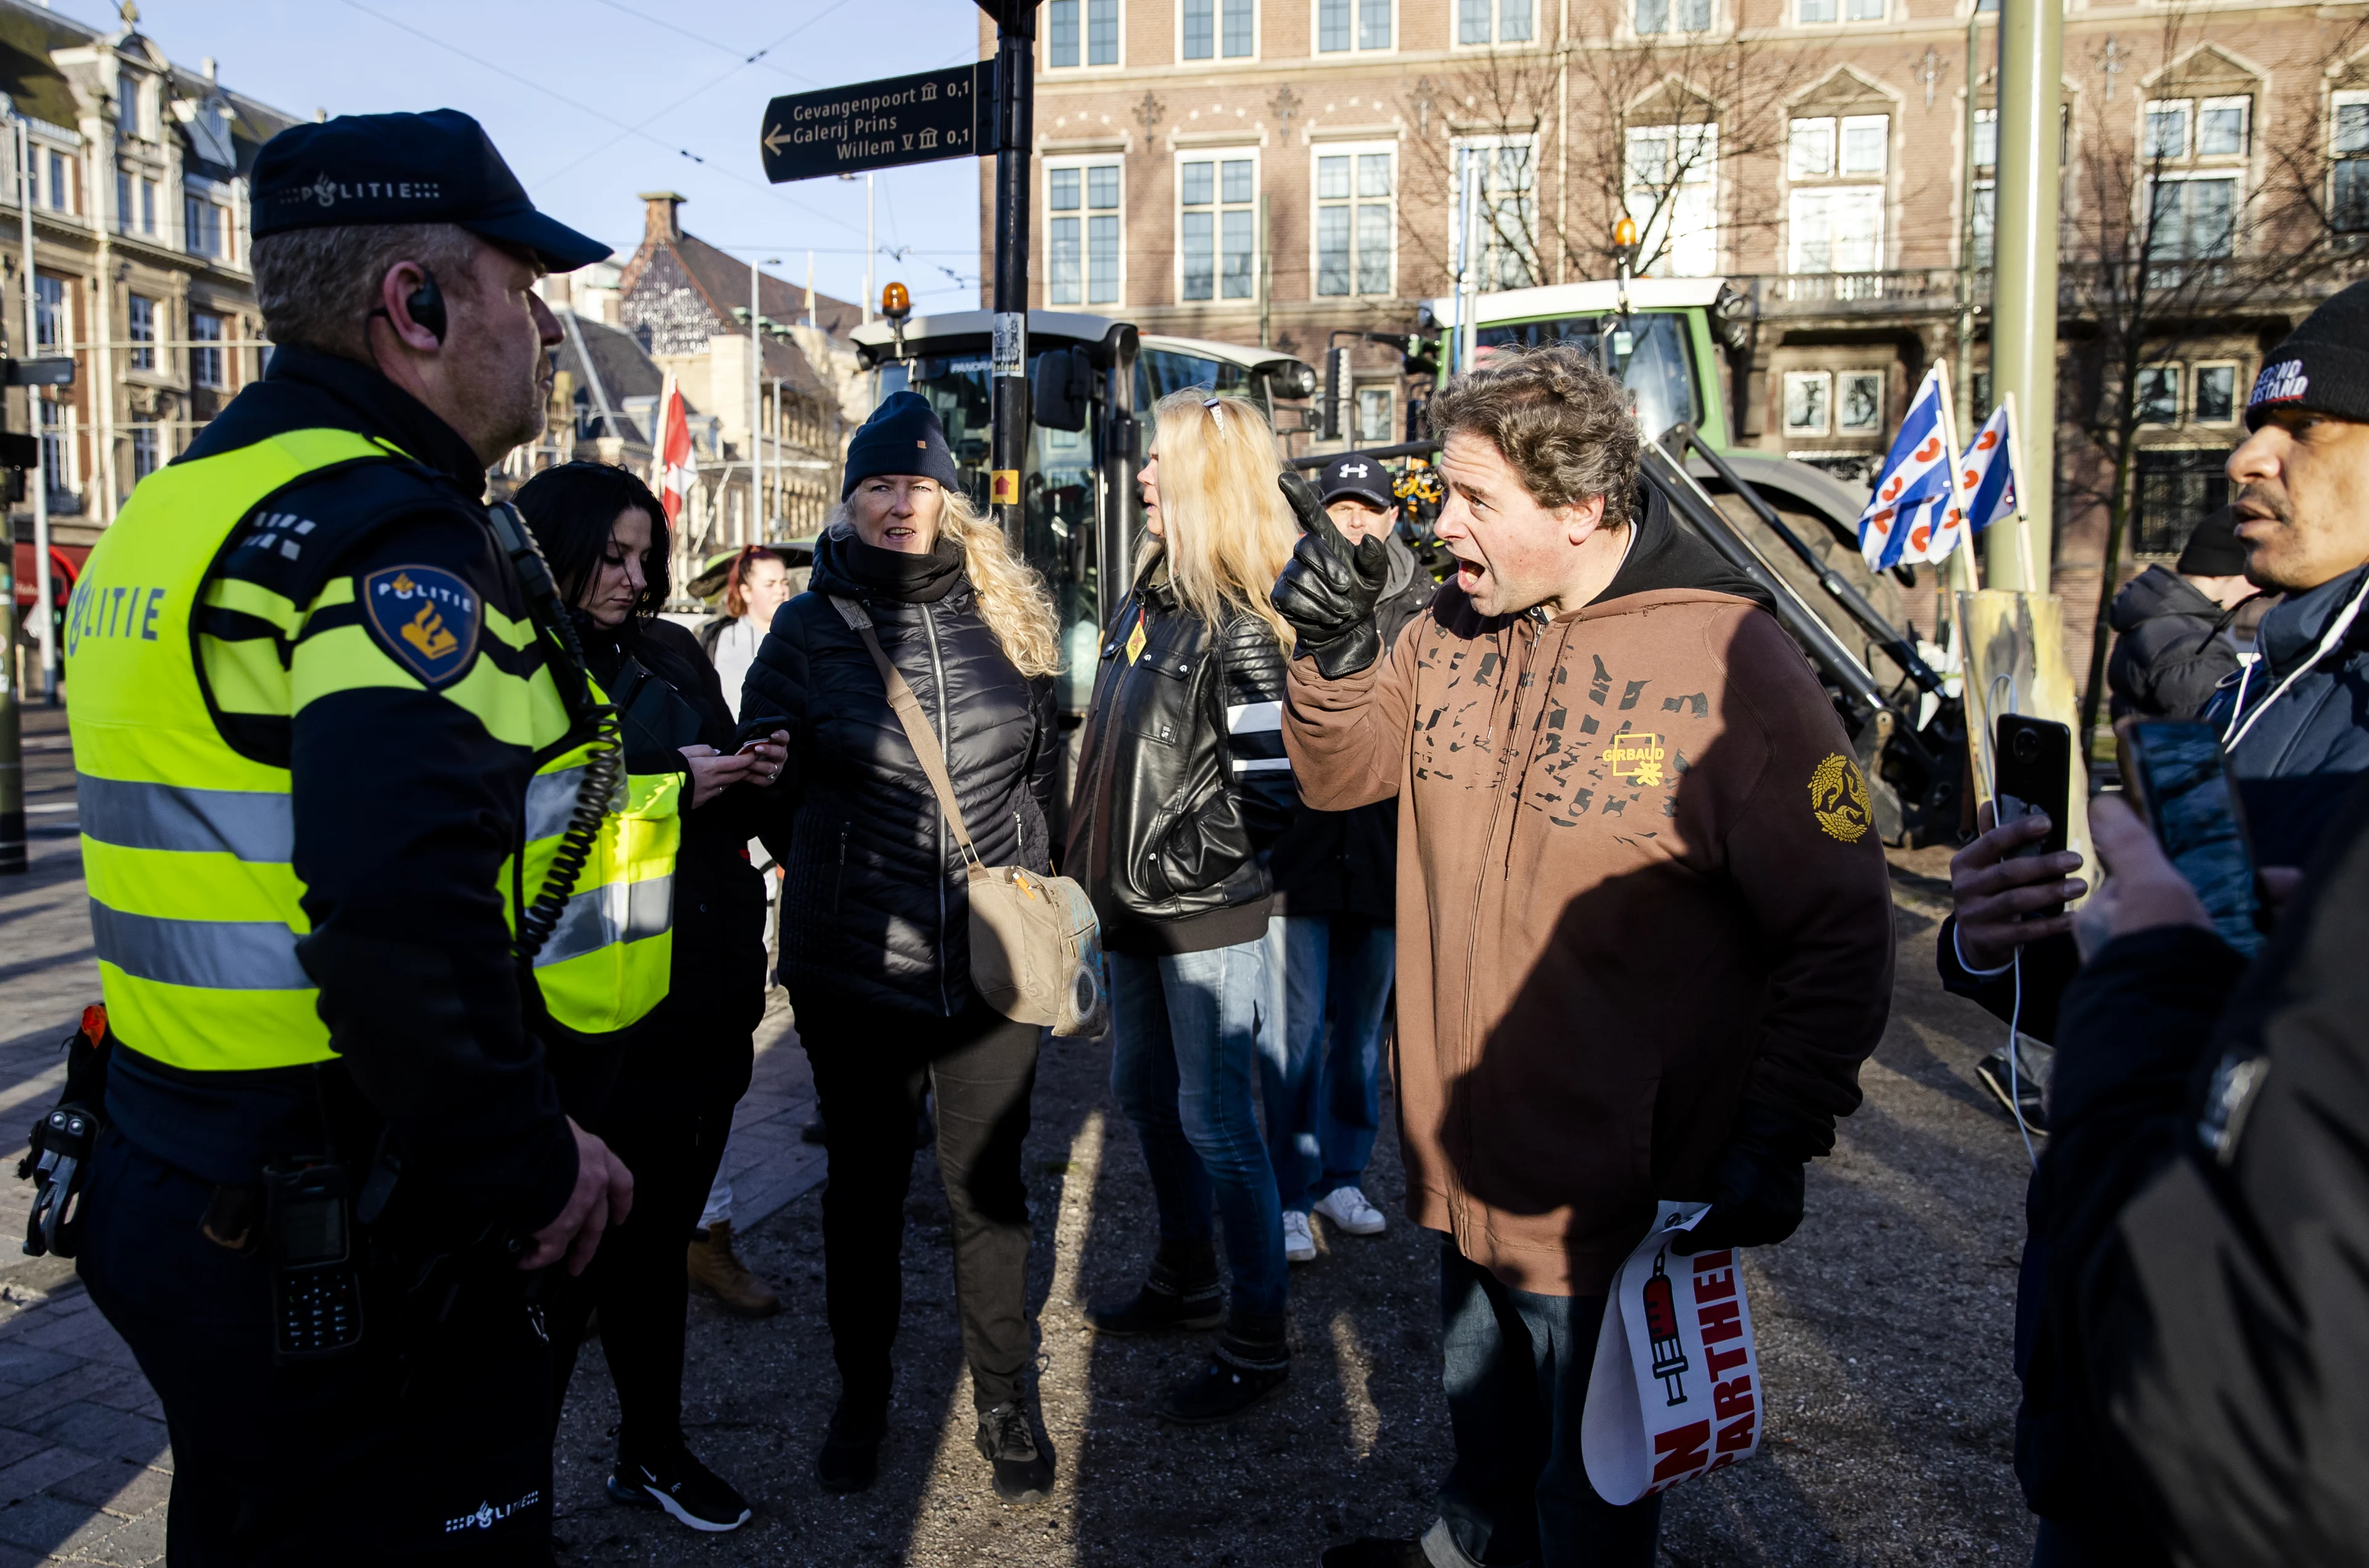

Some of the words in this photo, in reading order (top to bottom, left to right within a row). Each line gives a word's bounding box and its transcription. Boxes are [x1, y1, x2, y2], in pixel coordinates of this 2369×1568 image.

[793, 88, 916, 121] Gevangenpoort
[947, 80, 969, 97] 0,1
[793, 122, 848, 144] Galerij
[854, 115, 897, 135] Prins
[837, 139, 895, 160] Willem
[901, 133, 914, 151] V
[946, 128, 969, 146] 0,1
[301, 183, 411, 207] POLITIE
[378, 582, 472, 613] POLITIE
[1602, 748, 1664, 762] GIRBAUD
[466, 1495, 527, 1528] POLITIE
